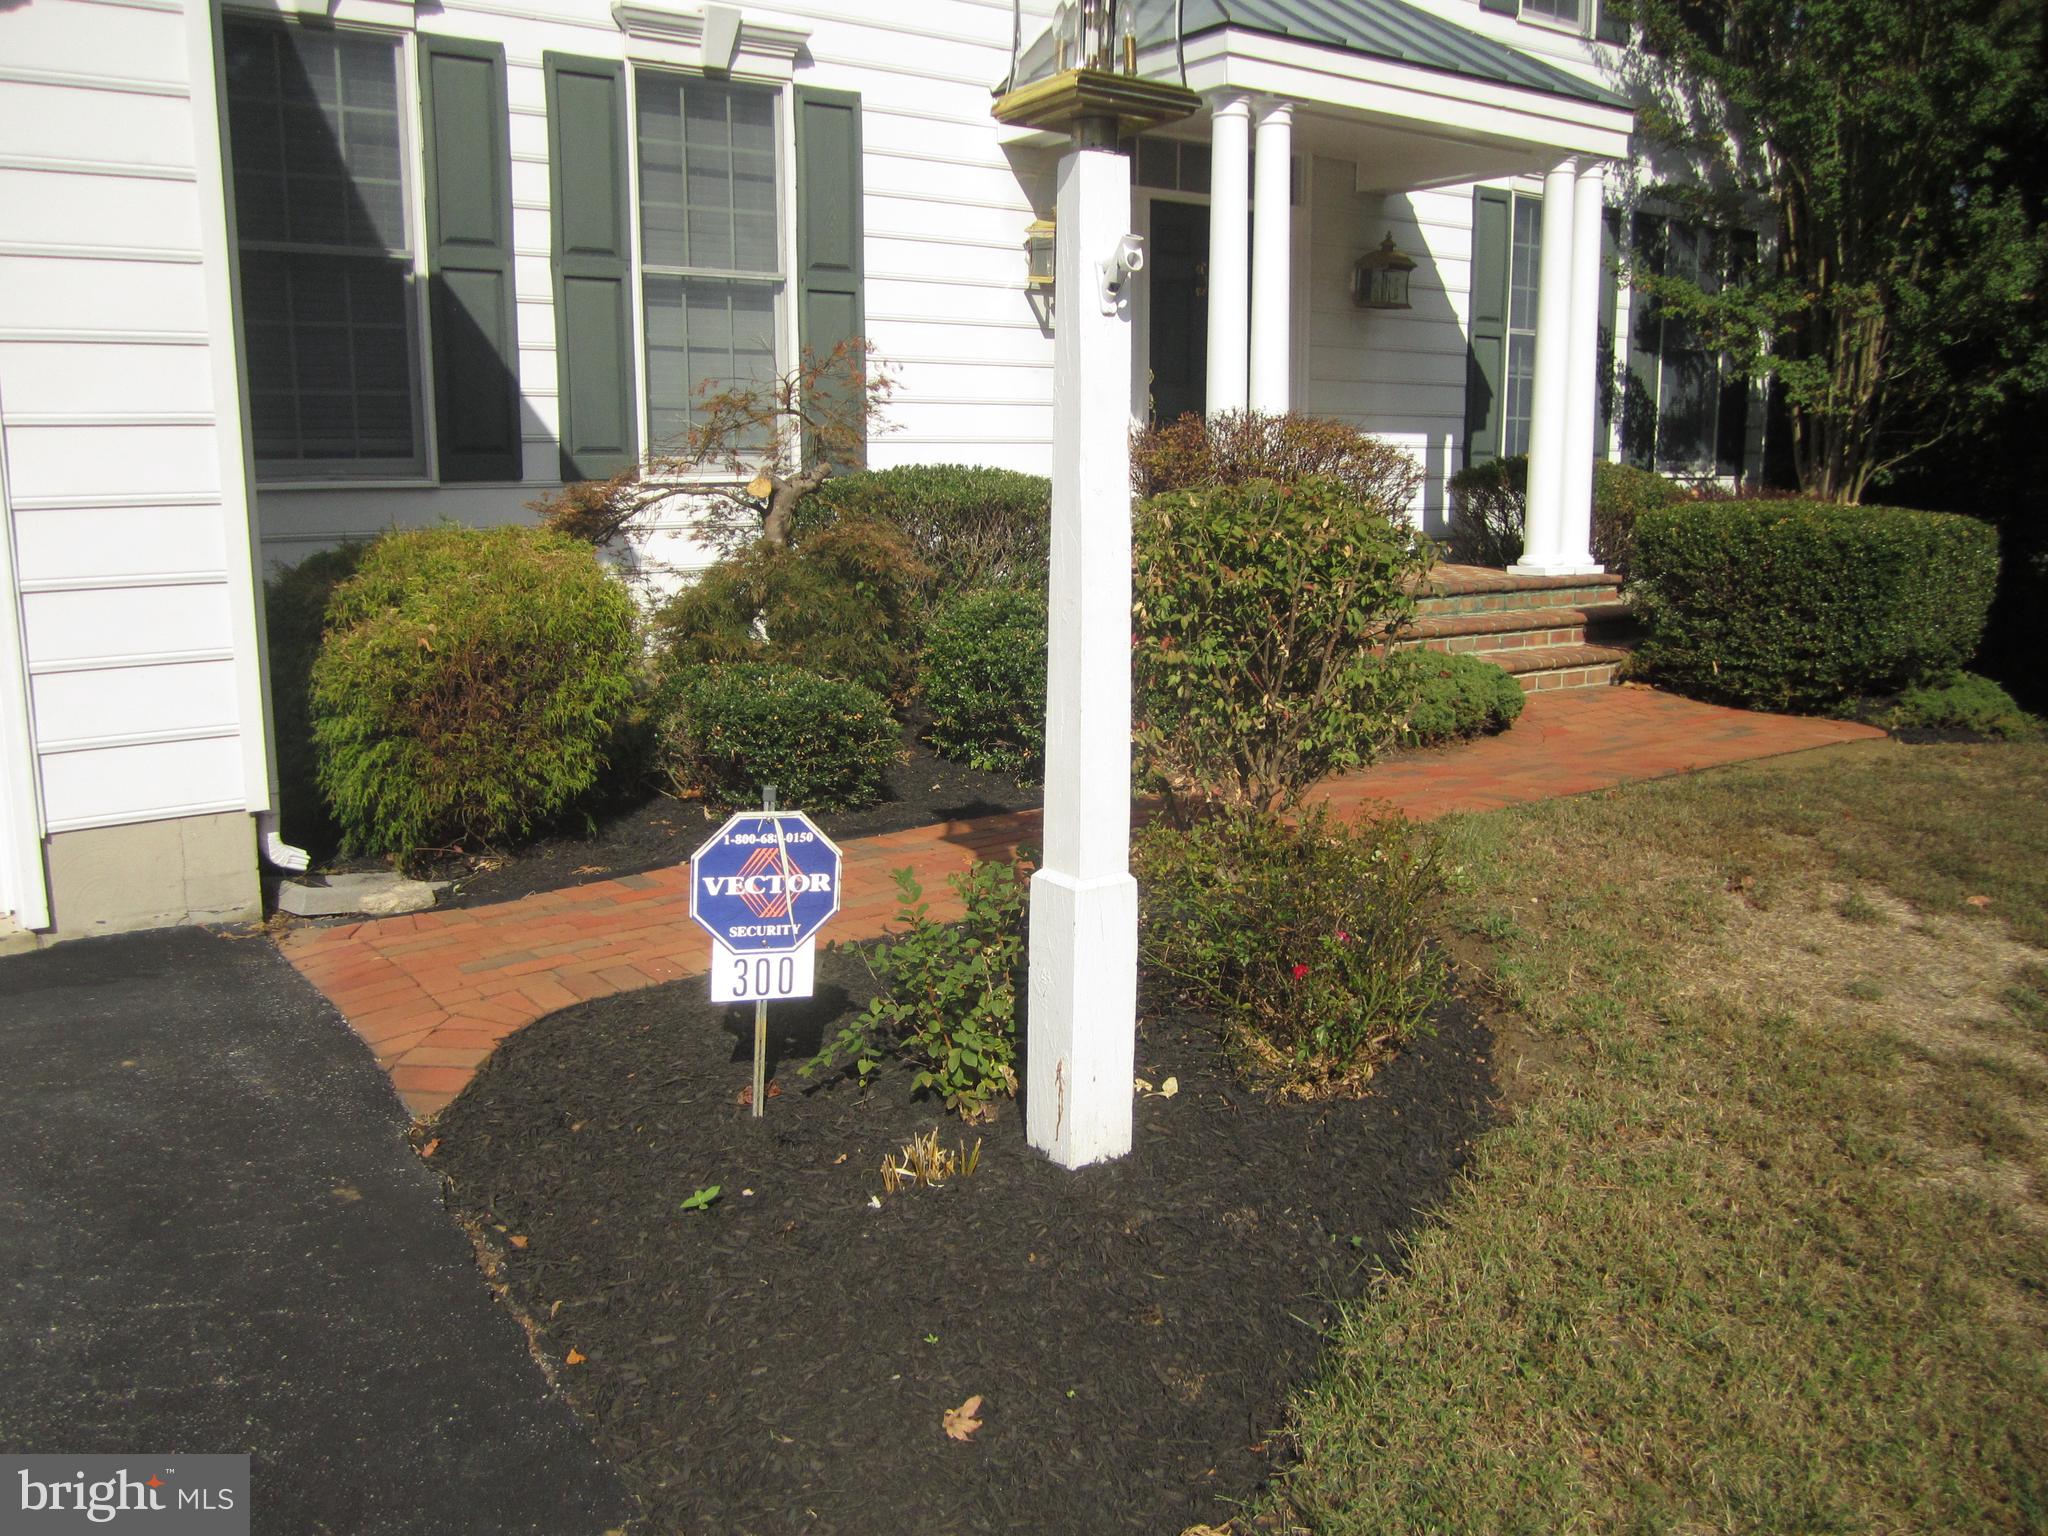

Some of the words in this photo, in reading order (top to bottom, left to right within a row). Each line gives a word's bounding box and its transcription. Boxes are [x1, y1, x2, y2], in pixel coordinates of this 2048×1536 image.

[702, 873, 832, 896] VECTOR
[728, 923, 802, 938] SECURITY
[732, 956, 794, 997] 300
